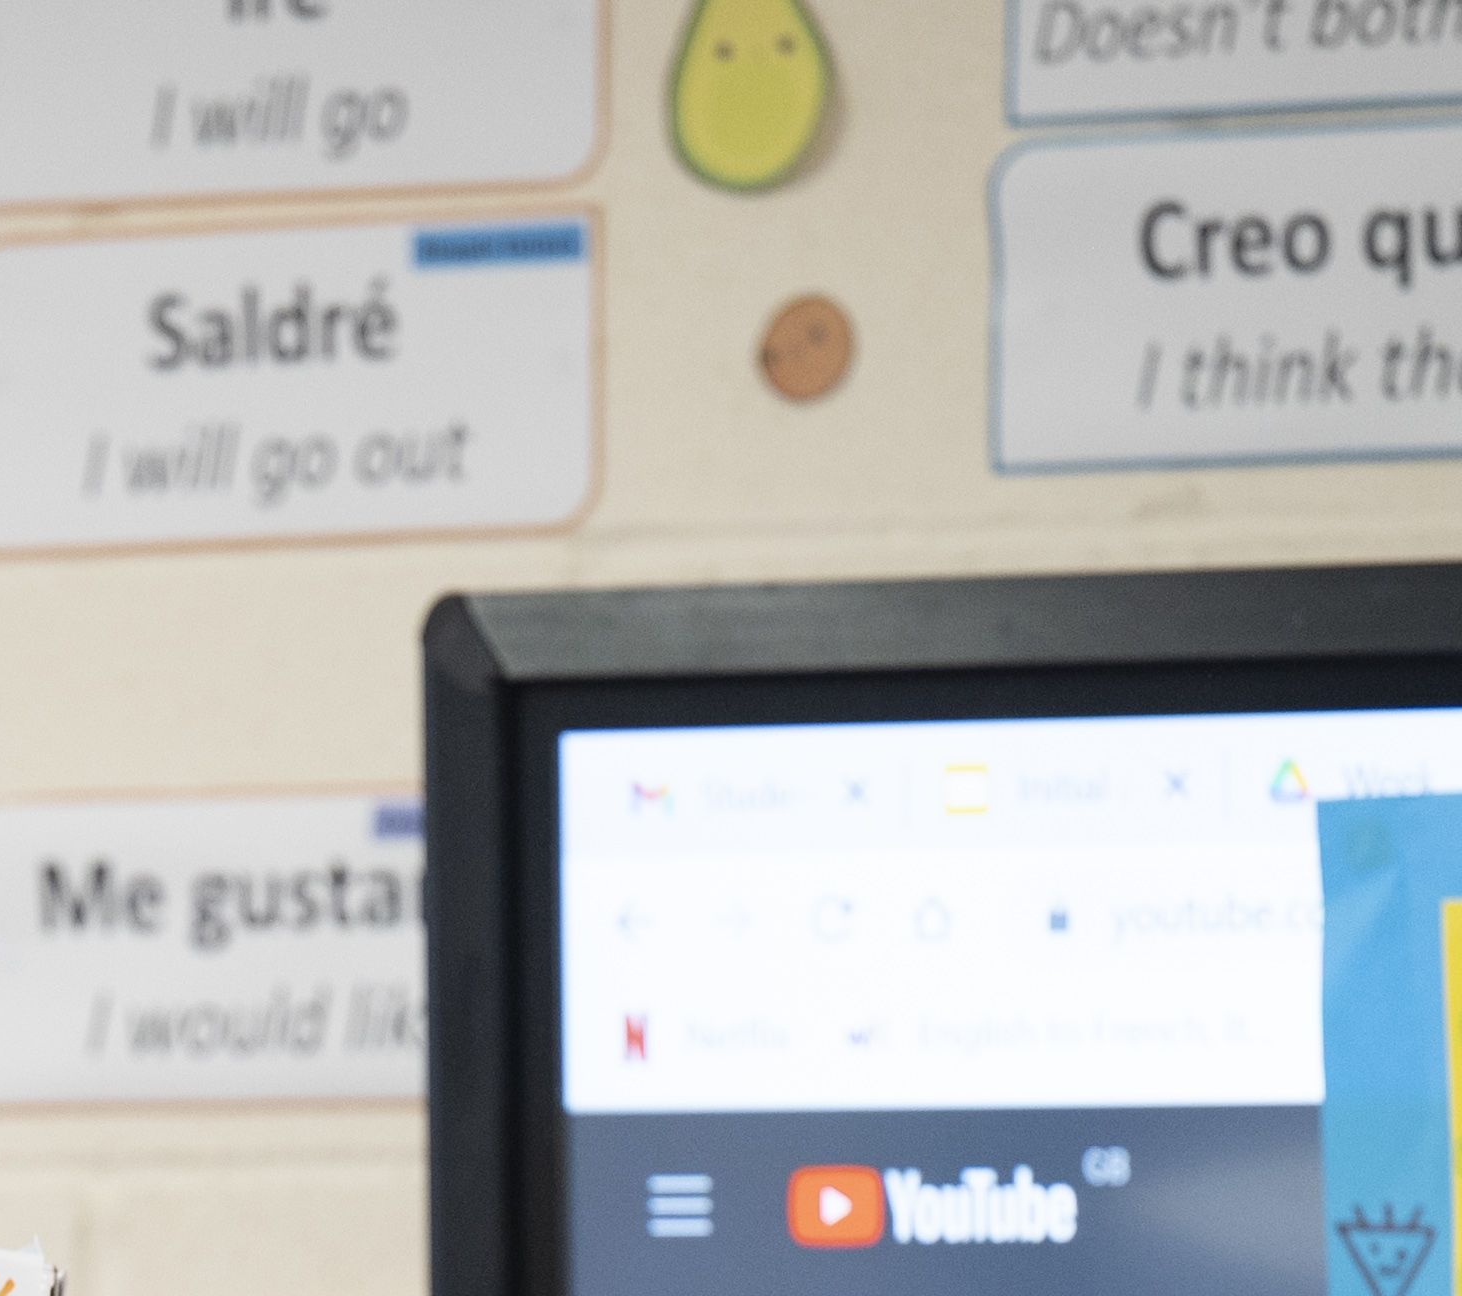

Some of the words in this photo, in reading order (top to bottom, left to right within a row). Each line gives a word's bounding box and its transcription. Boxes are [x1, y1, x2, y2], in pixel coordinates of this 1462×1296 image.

[321, 86, 410, 160] go
[1136, 200, 1332, 280] Creo
[146, 277, 400, 372] Saldré
[1136, 343, 1162, 412] I
[1180, 330, 1360, 410] think
[250, 432, 340, 508] go
[353, 422, 470, 488] out
[38, 857, 166, 934] Me
[188, 862, 425, 953] gusta
[882, 1164, 1078, 1246] YouTube
